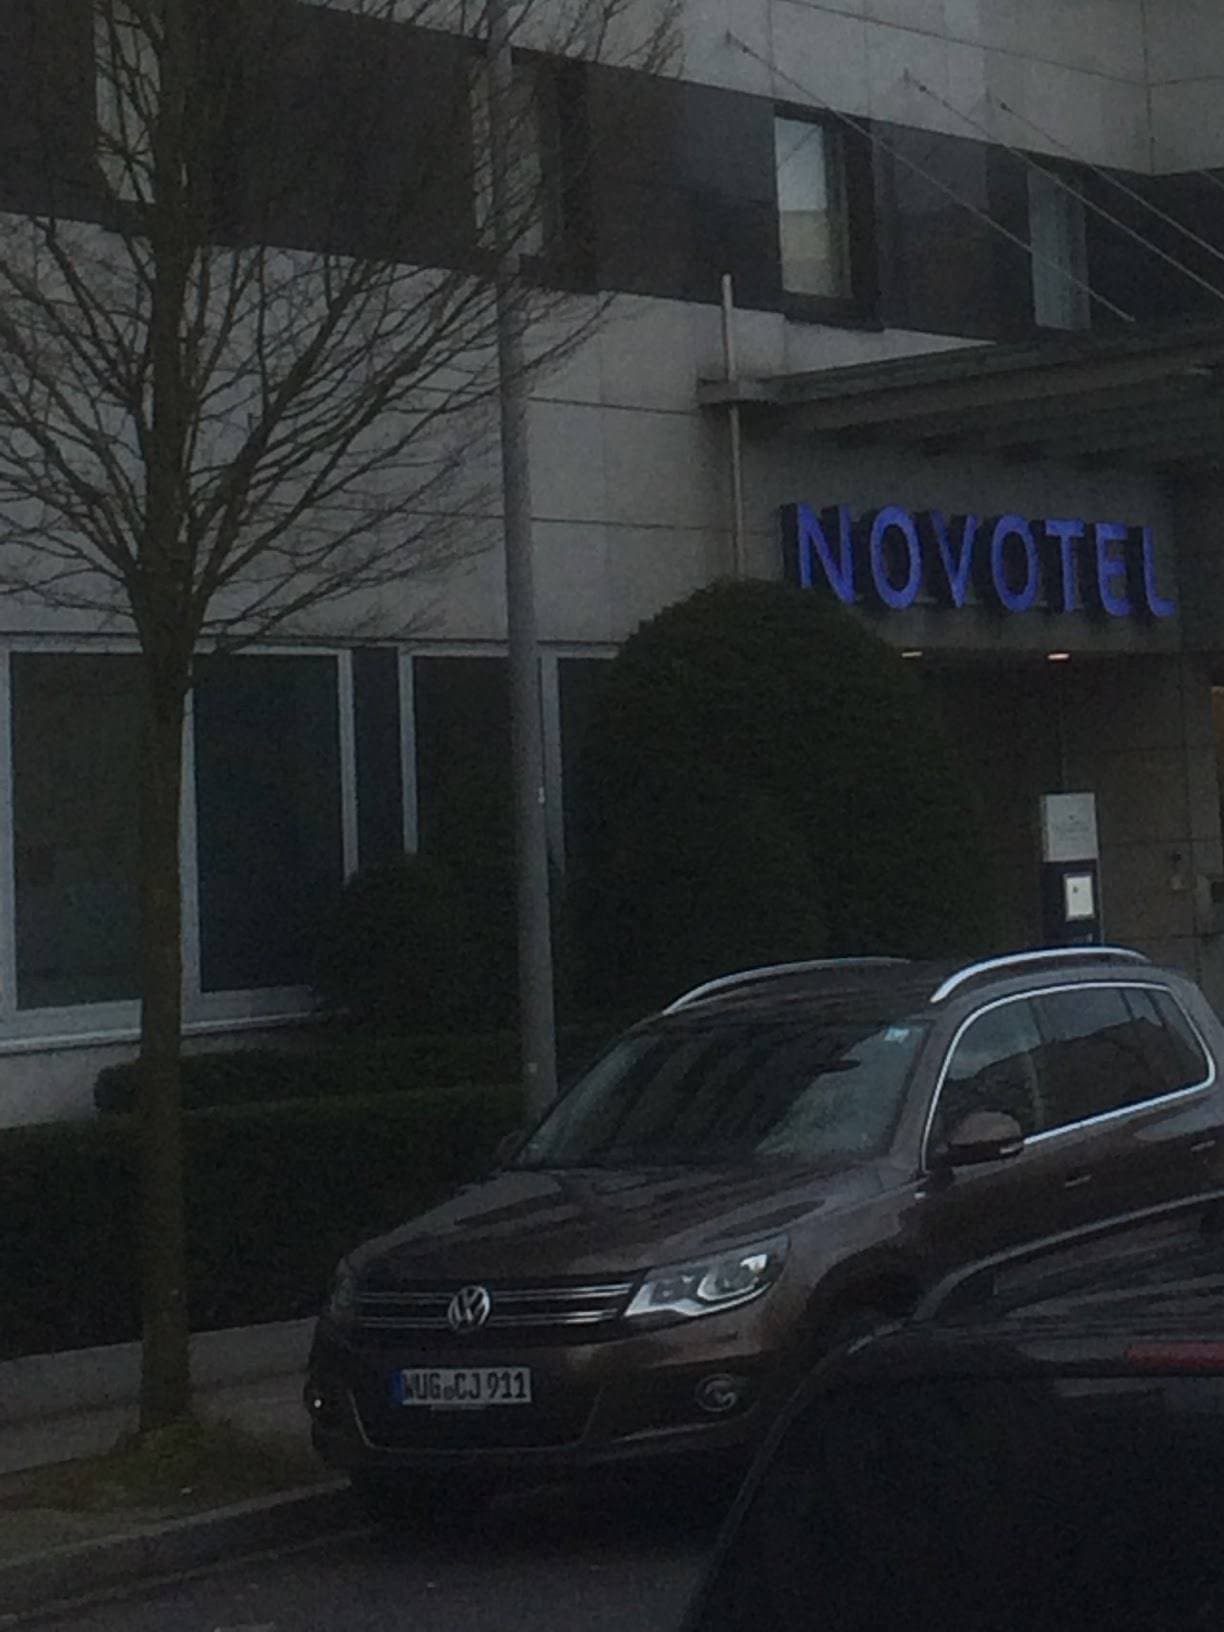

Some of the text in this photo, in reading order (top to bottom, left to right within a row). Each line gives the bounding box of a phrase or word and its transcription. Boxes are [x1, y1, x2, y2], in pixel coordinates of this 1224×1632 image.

[787, 501, 1178, 618] NOVOTEL
[454, 1372, 481, 1400] CJ
[487, 1371, 527, 1399] 911
